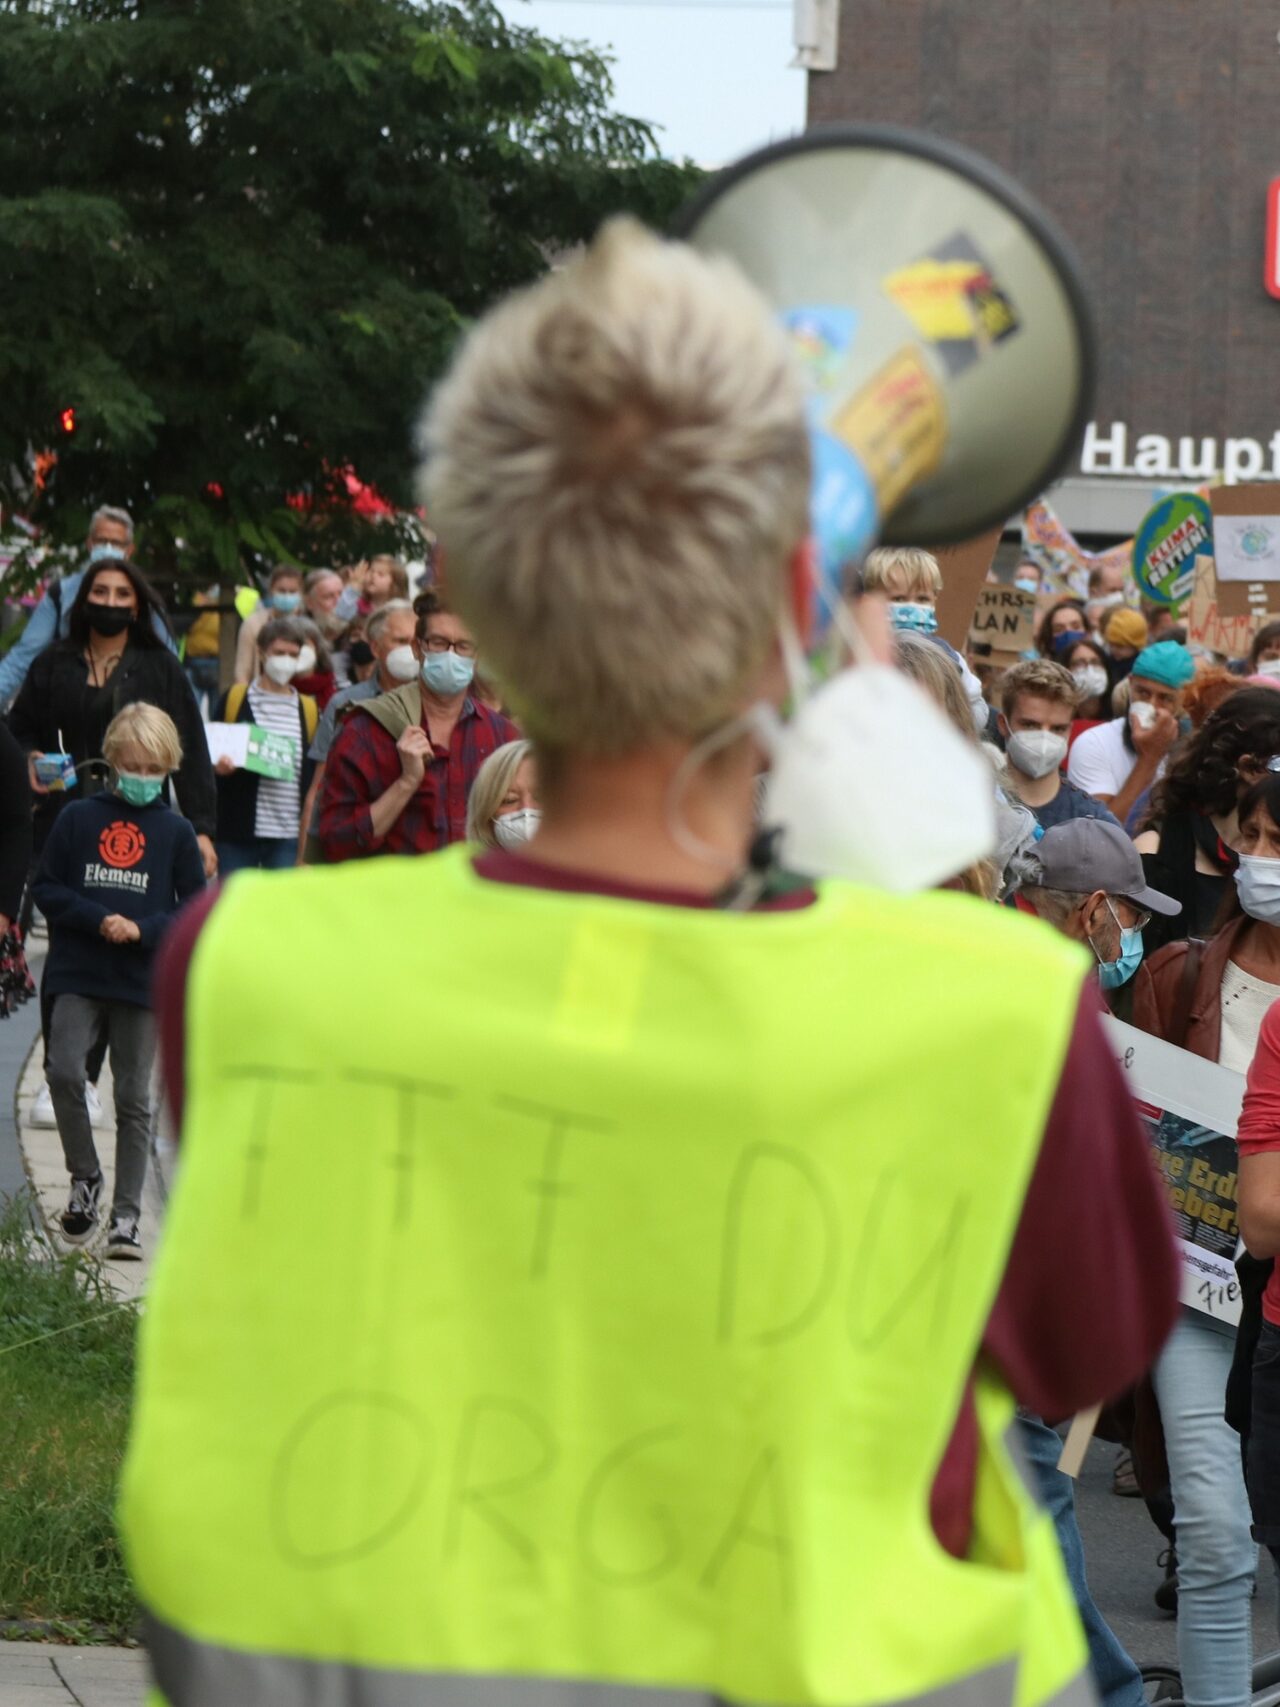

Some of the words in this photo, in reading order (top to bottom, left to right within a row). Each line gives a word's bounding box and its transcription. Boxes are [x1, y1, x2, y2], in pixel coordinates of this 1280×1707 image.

[1147, 519, 1197, 568] KLIMA
[84, 863, 150, 889] Element
[714, 1138, 973, 1354] DU
[267, 1387, 797, 1608] ORGA
